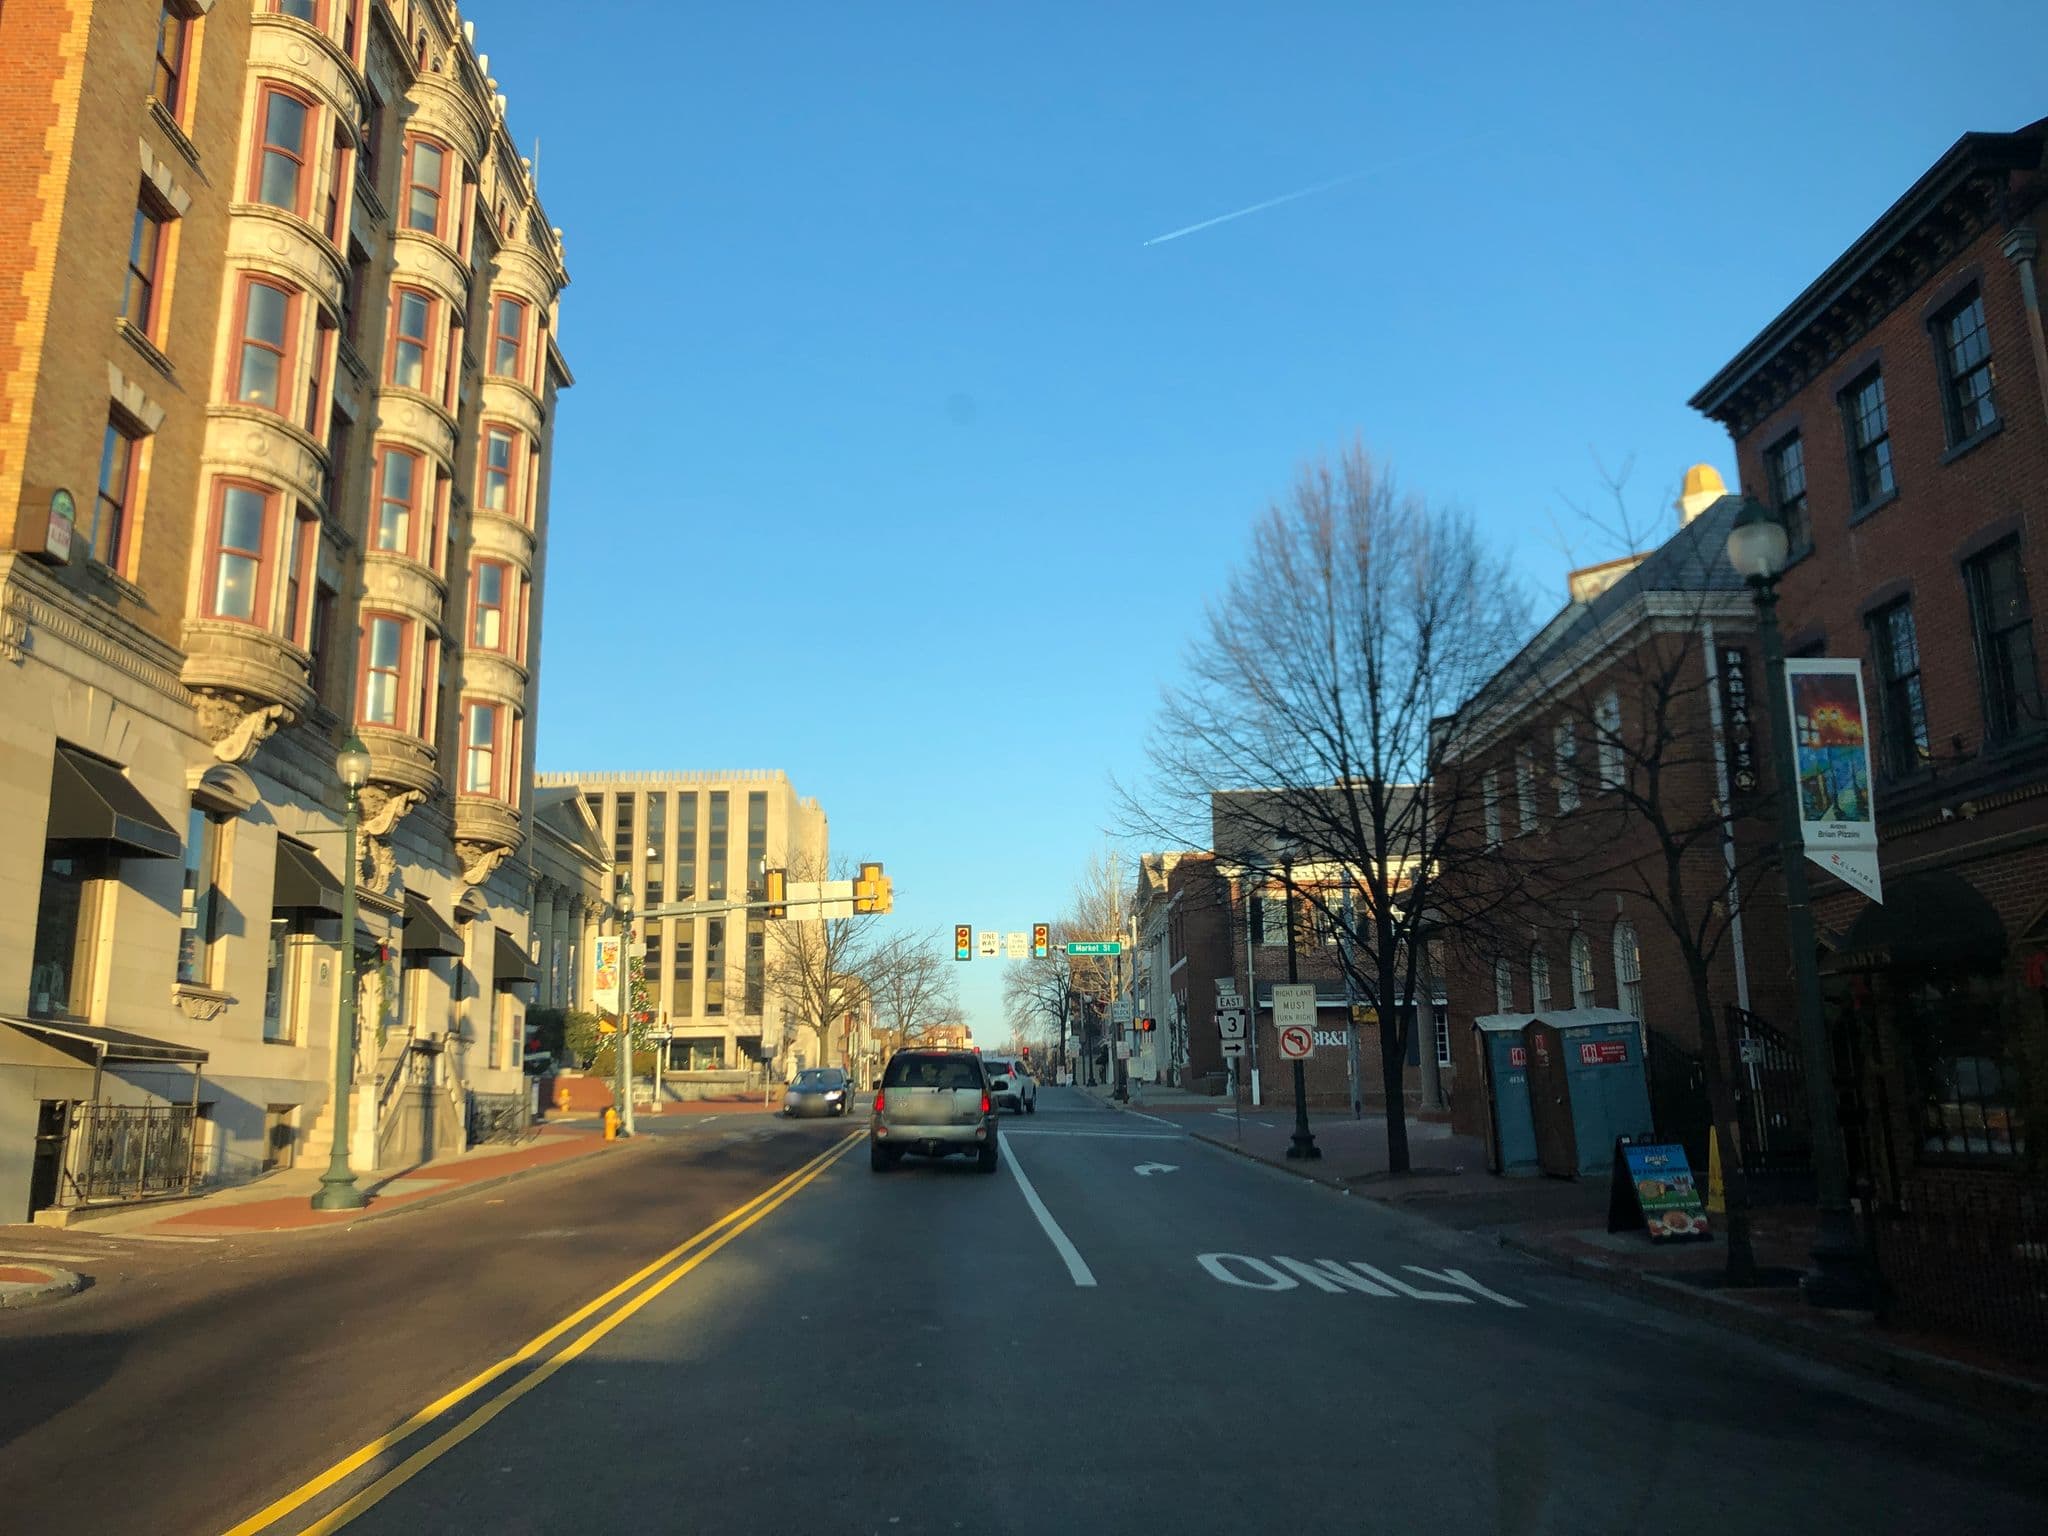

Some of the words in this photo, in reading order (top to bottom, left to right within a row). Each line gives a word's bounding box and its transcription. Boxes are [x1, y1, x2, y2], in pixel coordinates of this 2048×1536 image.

[1817, 830, 1836, 838] Brian
[1075, 944, 1099, 952] Market
[1103, 944, 1111, 952] St
[1275, 990, 1293, 998] RIGHT
[1220, 998, 1241, 1007] EAST
[1283, 1002, 1305, 1010] MUST
[1227, 1016, 1238, 1032] 3
[1196, 1252, 1528, 1308] ONLY
